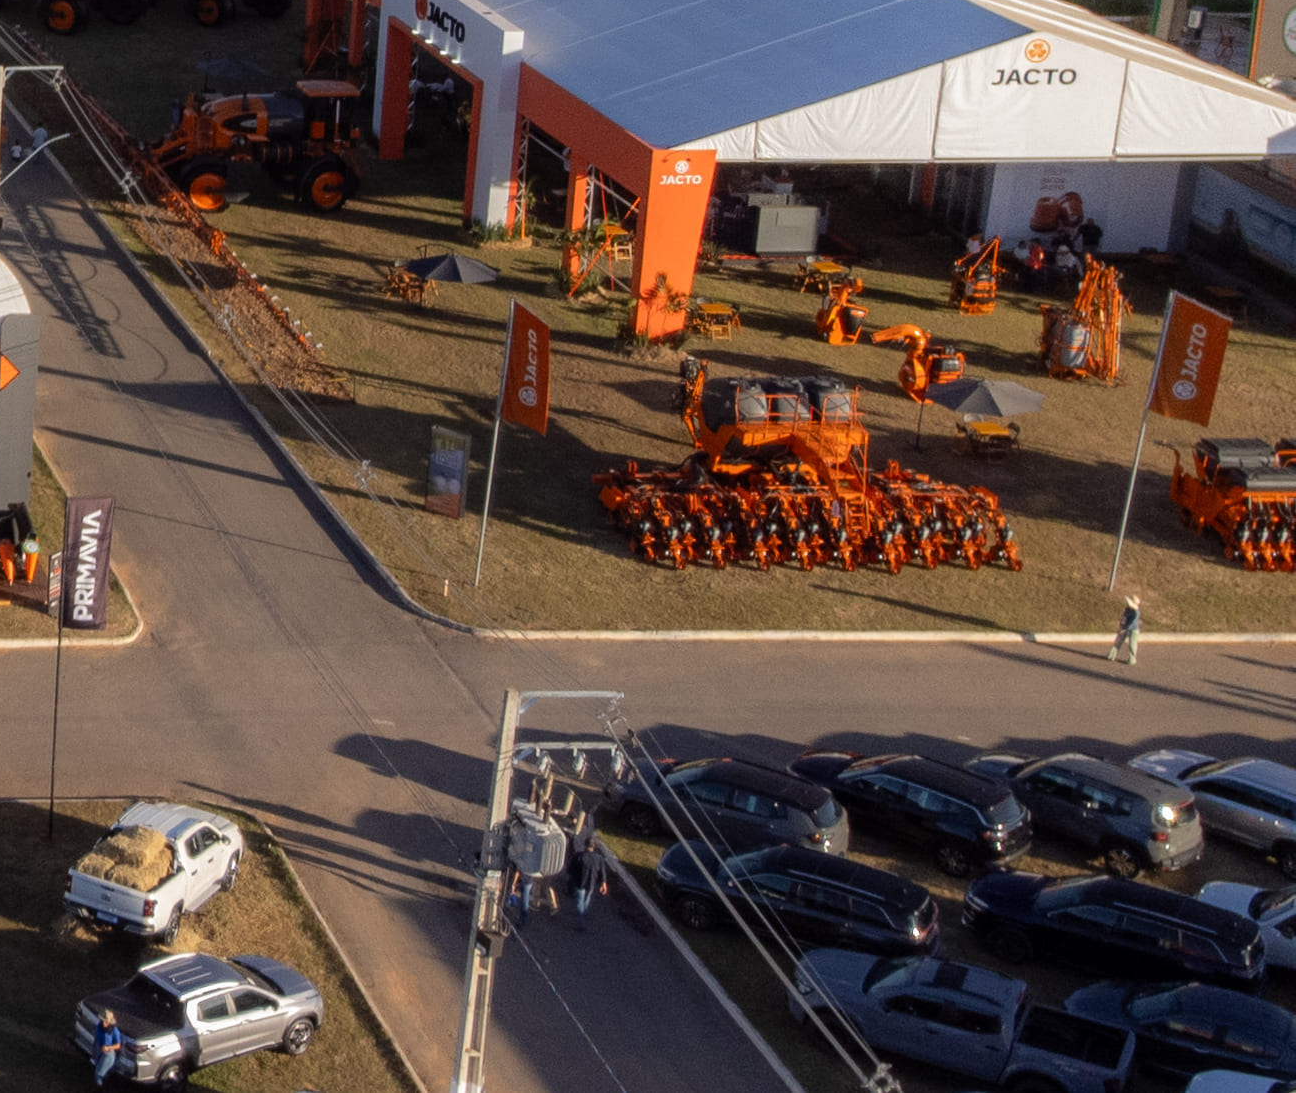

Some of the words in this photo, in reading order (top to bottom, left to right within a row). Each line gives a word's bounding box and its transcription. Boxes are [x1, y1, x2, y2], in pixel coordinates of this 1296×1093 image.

[426, 0, 467, 44] JACTO
[991, 68, 1077, 86] JACTO
[659, 174, 702, 185] JACTO
[524, 328, 538, 387] JACTO
[1183, 322, 1208, 381] JACTO
[72, 509, 103, 623] PRIMAVIA
